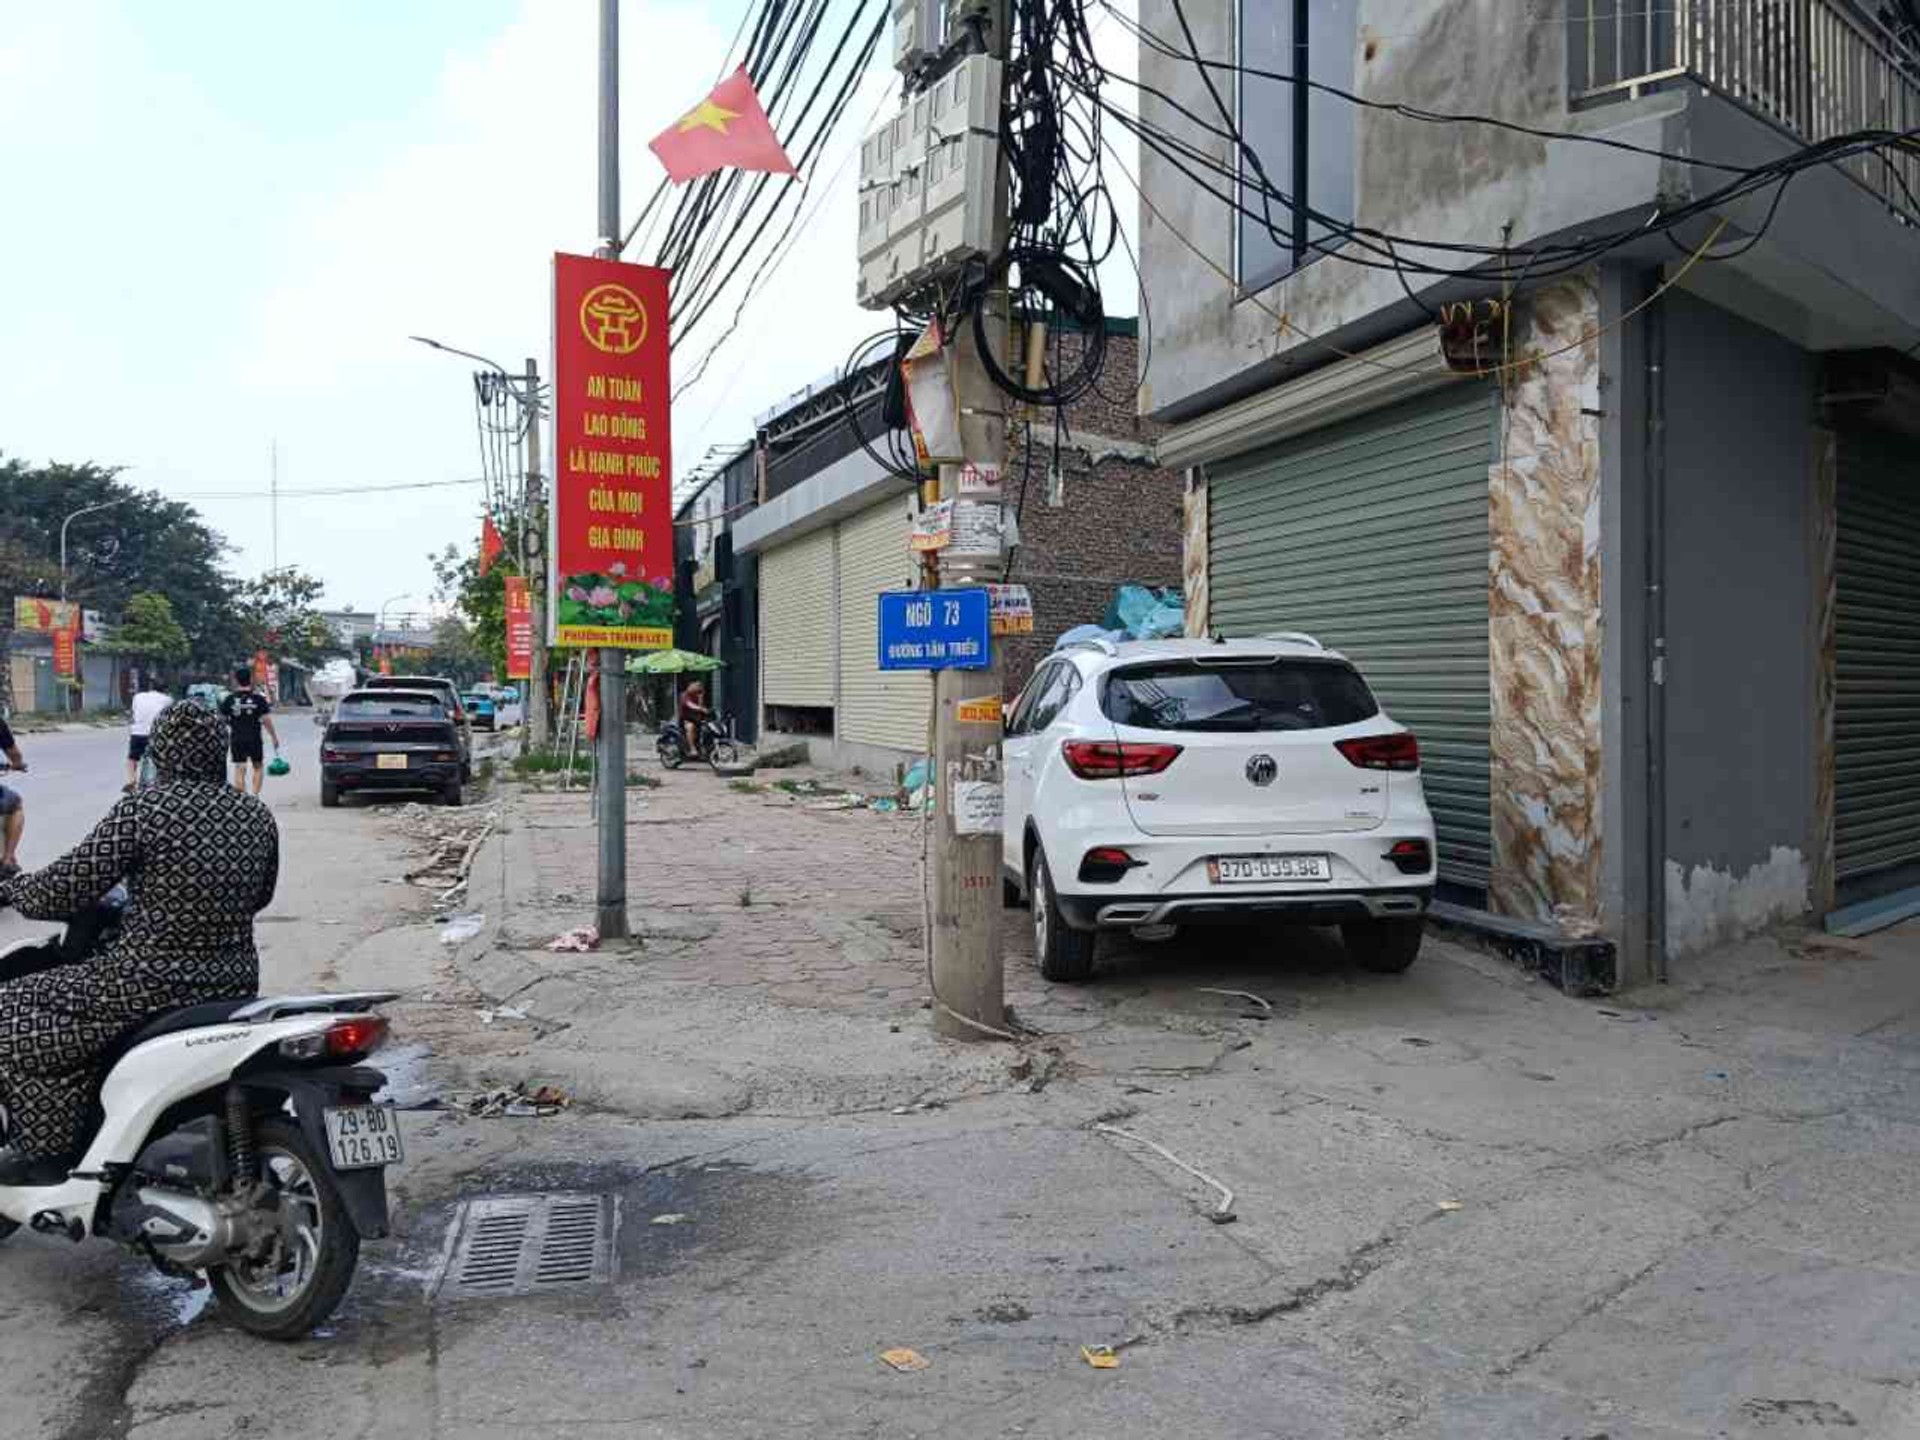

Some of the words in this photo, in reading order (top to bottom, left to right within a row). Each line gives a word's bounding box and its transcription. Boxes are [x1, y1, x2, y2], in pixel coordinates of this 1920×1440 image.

[587, 375, 605, 398] AN
[584, 412, 607, 436] LAO
[611, 412, 646, 443] ĐỘNG
[569, 446, 587, 472] LÀ
[589, 450, 624, 480] HẠNH
[627, 451, 661, 479] PHÚC
[589, 482, 615, 512] CỦA
[618, 491, 643, 518] MỌI
[588, 526, 610, 550] GIA
[905, 597, 932, 627] NGÕ
[943, 600, 960, 626] 73
